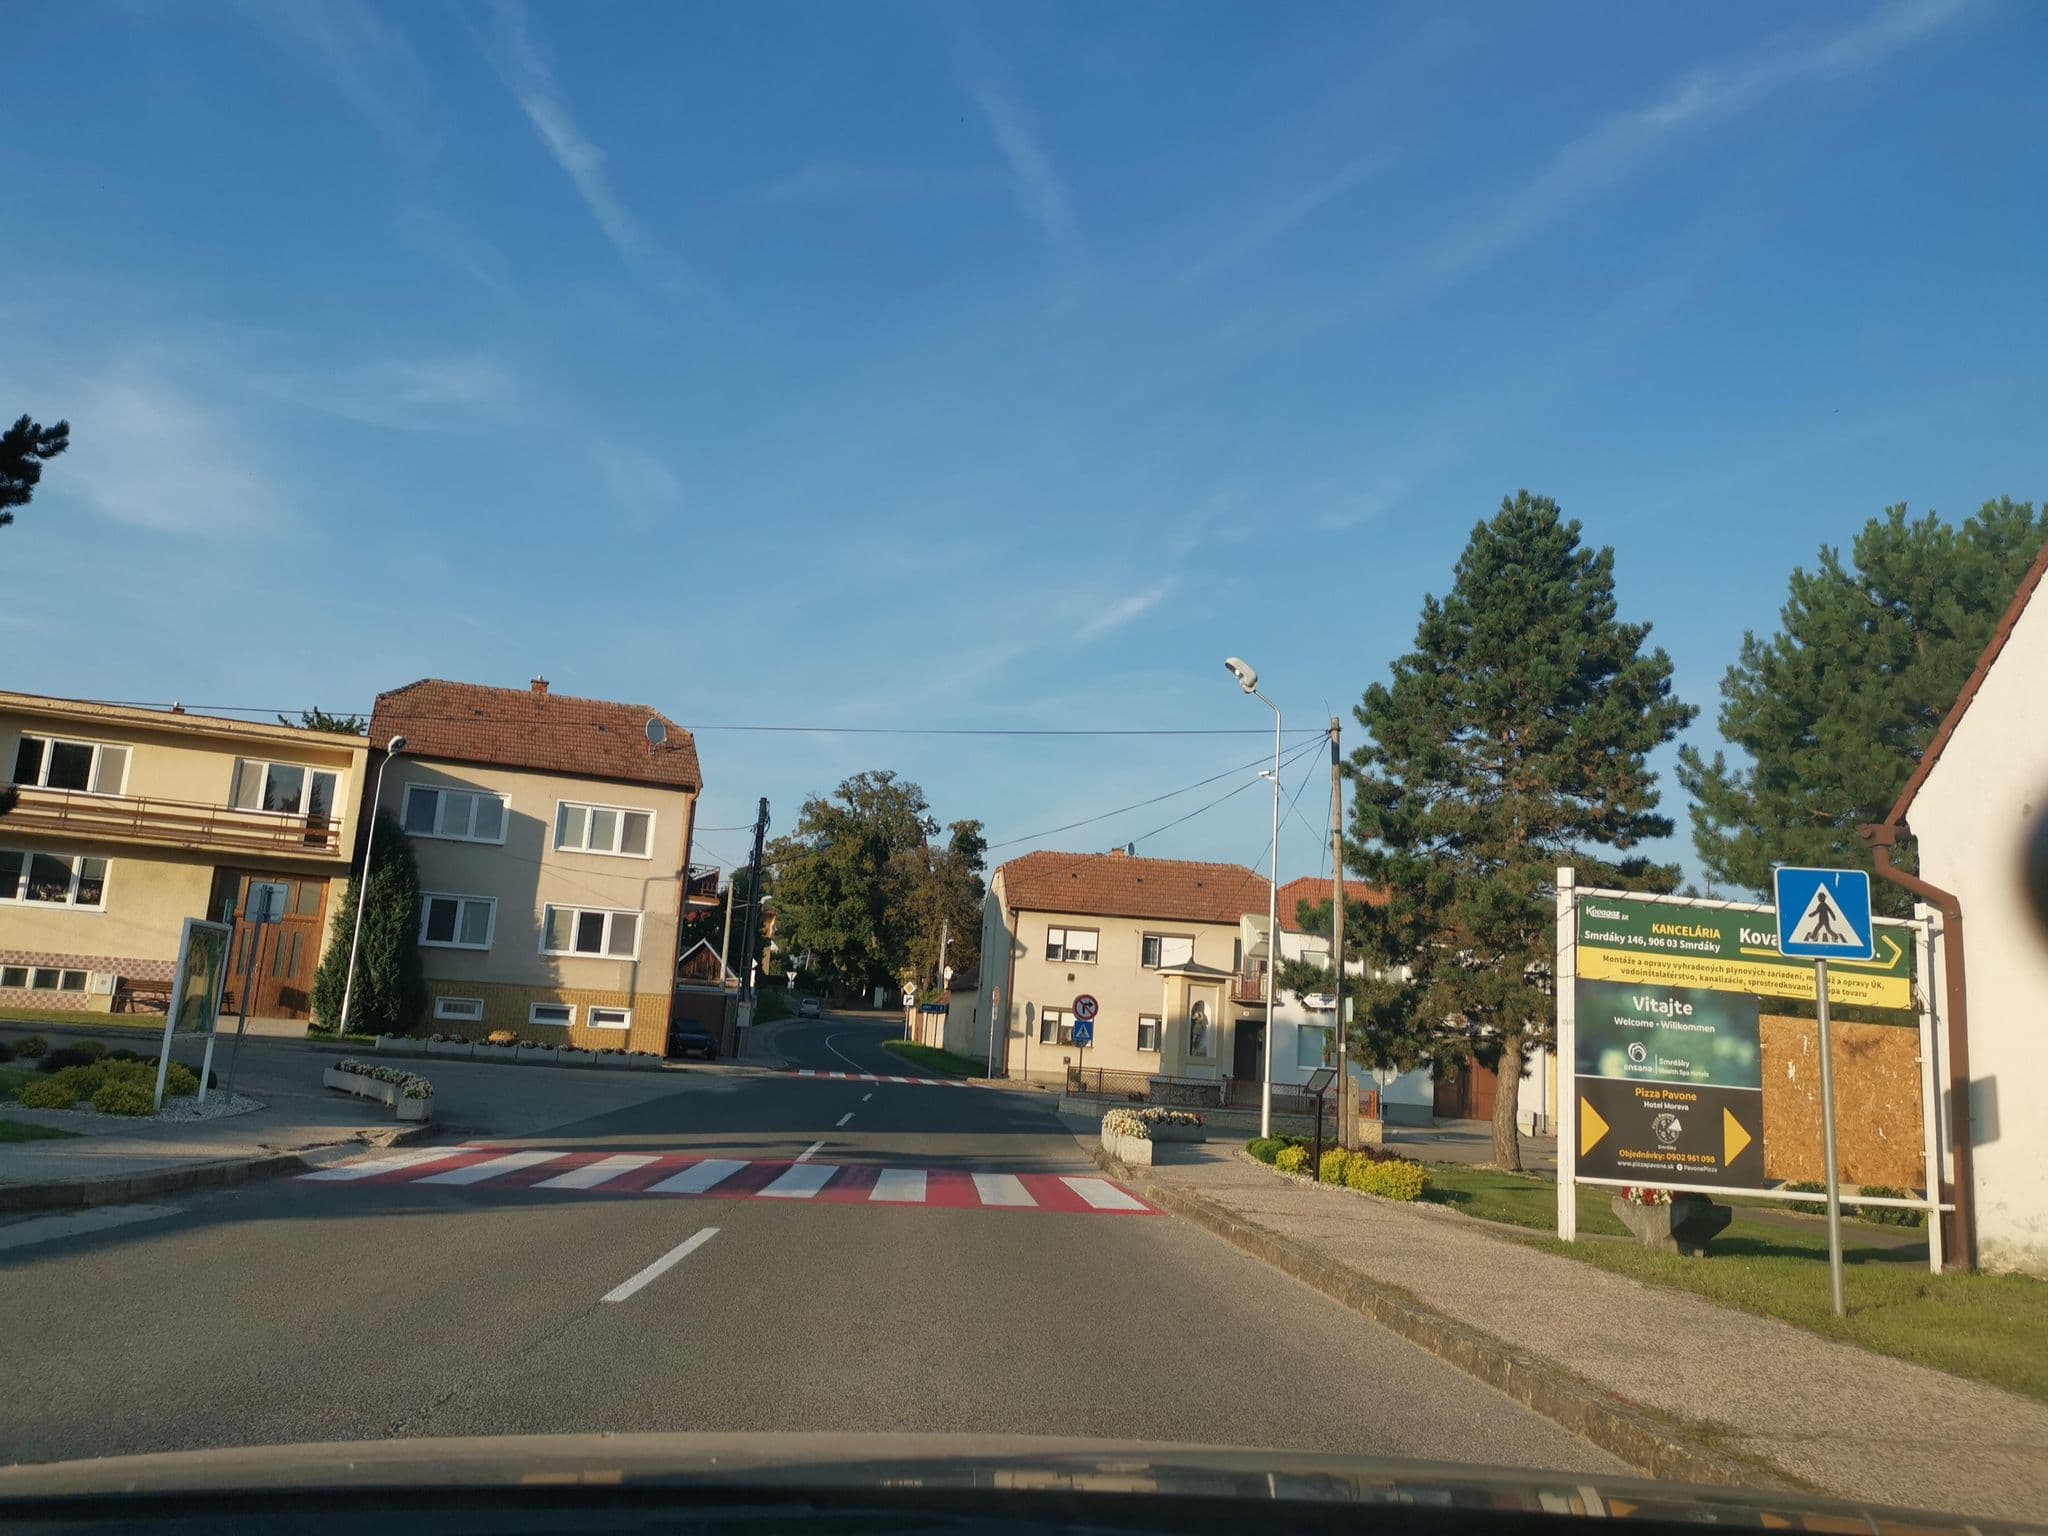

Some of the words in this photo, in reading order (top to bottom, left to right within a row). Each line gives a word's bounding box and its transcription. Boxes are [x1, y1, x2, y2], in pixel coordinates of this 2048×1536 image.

[1652, 923, 1721, 939] KANCELÁRIA
[1740, 928, 1778, 946] Kova
[1584, 930, 1625, 944] Smrdáky
[1627, 935, 1647, 947] 146,
[1648, 937, 1665, 947] 906
[1667, 938, 1678, 948] 03
[1680, 939, 1720, 954] Smrdáky
[1603, 955, 1636, 966] Montáže
[1644, 960, 1672, 970] opravy
[1673, 962, 1724, 974] vyhradených
[1726, 967, 1766, 977] plynových
[1767, 970, 1804, 981] zariadení,
[1843, 979, 1869, 989] opravy
[1700, 974, 1746, 986] kanalizácie,
[1748, 979, 1813, 992] sprostredkovanie
[1842, 986, 1867, 998] tovaru
[1632, 996, 1693, 1017] Vitajte
[1614, 1016, 1654, 1028] Welcome
[1660, 1020, 1716, 1032] Willkommen
[1623, 1064, 1653, 1072] ensana
[1659, 1057, 1690, 1068] Smrdáky
[1635, 1087, 1660, 1098] Pizza
[1662, 1090, 1697, 1101] Pavone
[1643, 1101, 1663, 1109] Hotel
[1619, 1149, 1665, 1160] Objednávky:
[1666, 1152, 1686, 1161] 0902
[1687, 1154, 1699, 1162] 961
